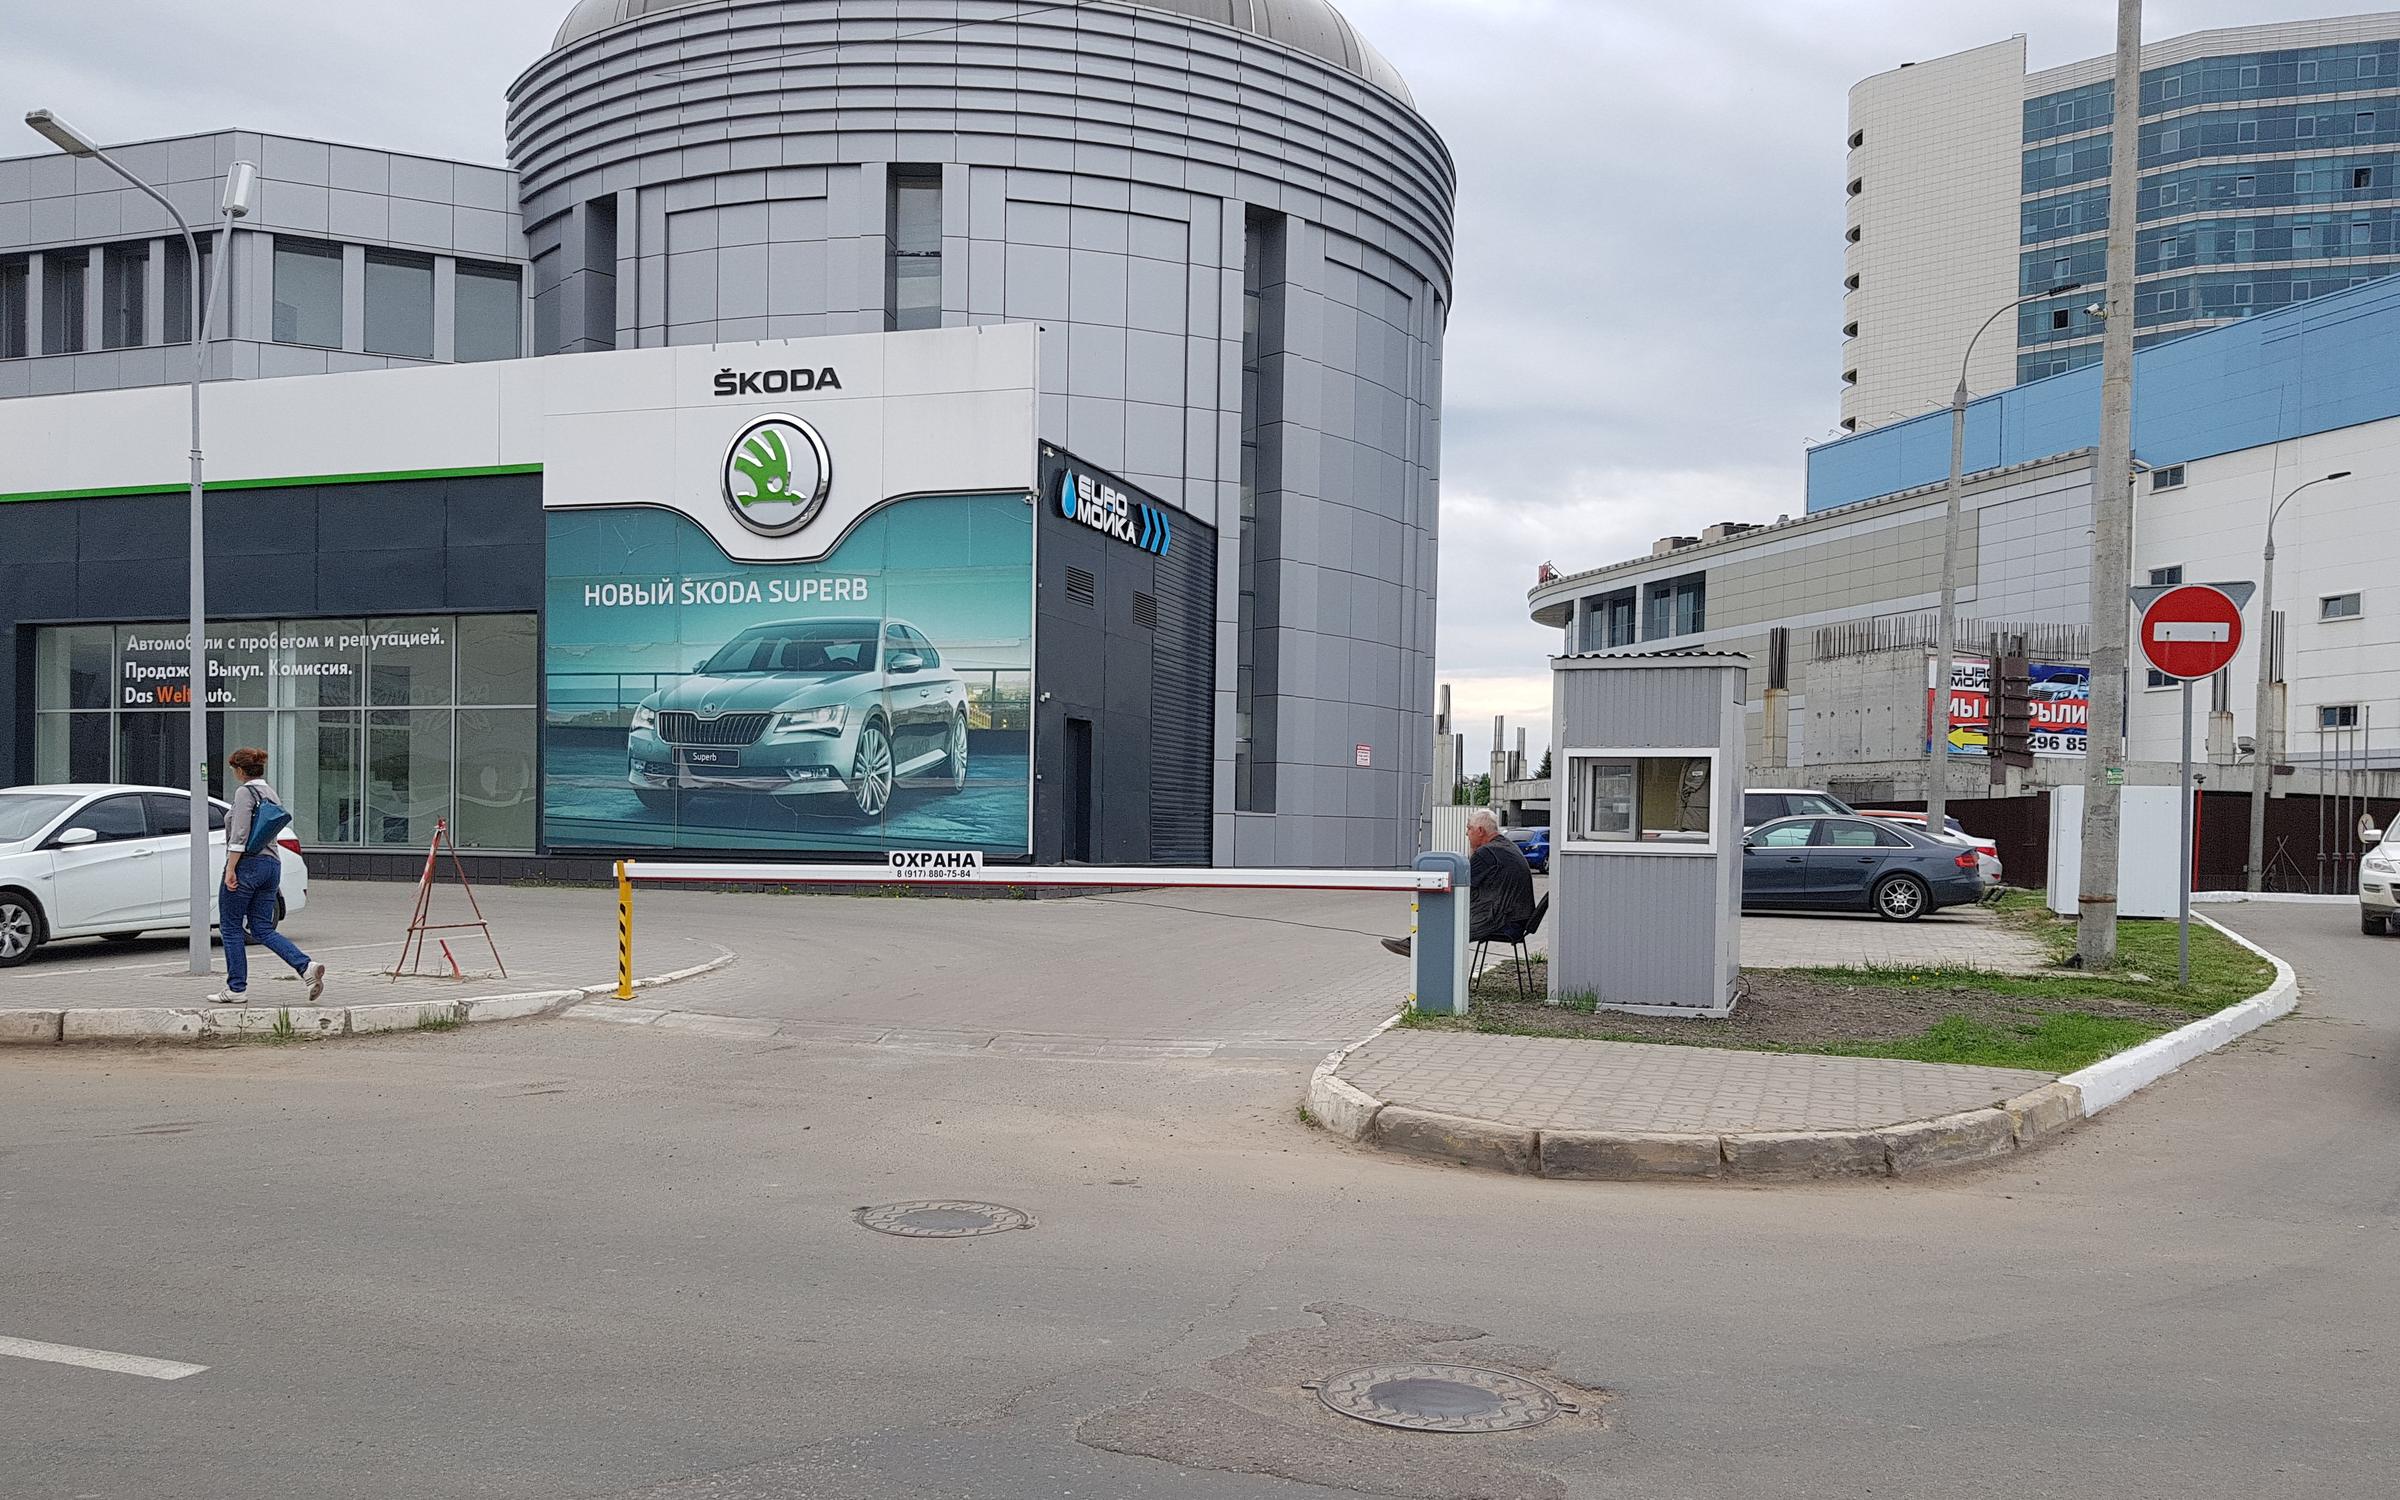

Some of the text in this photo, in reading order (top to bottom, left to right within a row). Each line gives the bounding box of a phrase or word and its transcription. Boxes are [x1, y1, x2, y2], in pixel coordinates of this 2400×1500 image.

[714, 367, 842, 396] ŠKODA
[1078, 474, 1128, 517] EURO
[584, 577, 869, 607] НОВЫЙ ŠKODA SUPERB
[126, 632, 223, 651] Автомобли
[239, 631, 319, 653] пробегом
[324, 636, 334, 647] и
[339, 627, 445, 651] репутацией.
[125, 658, 353, 682] Продаж Выкуп. Комиссия.
[125, 686, 154, 704] Das
[204, 688, 236, 703] uto.
[692, 752, 717, 762] Superb
[892, 853, 976, 868] ОХРАНА
[896, 869, 971, 878] 8 (917) 880-75-84
